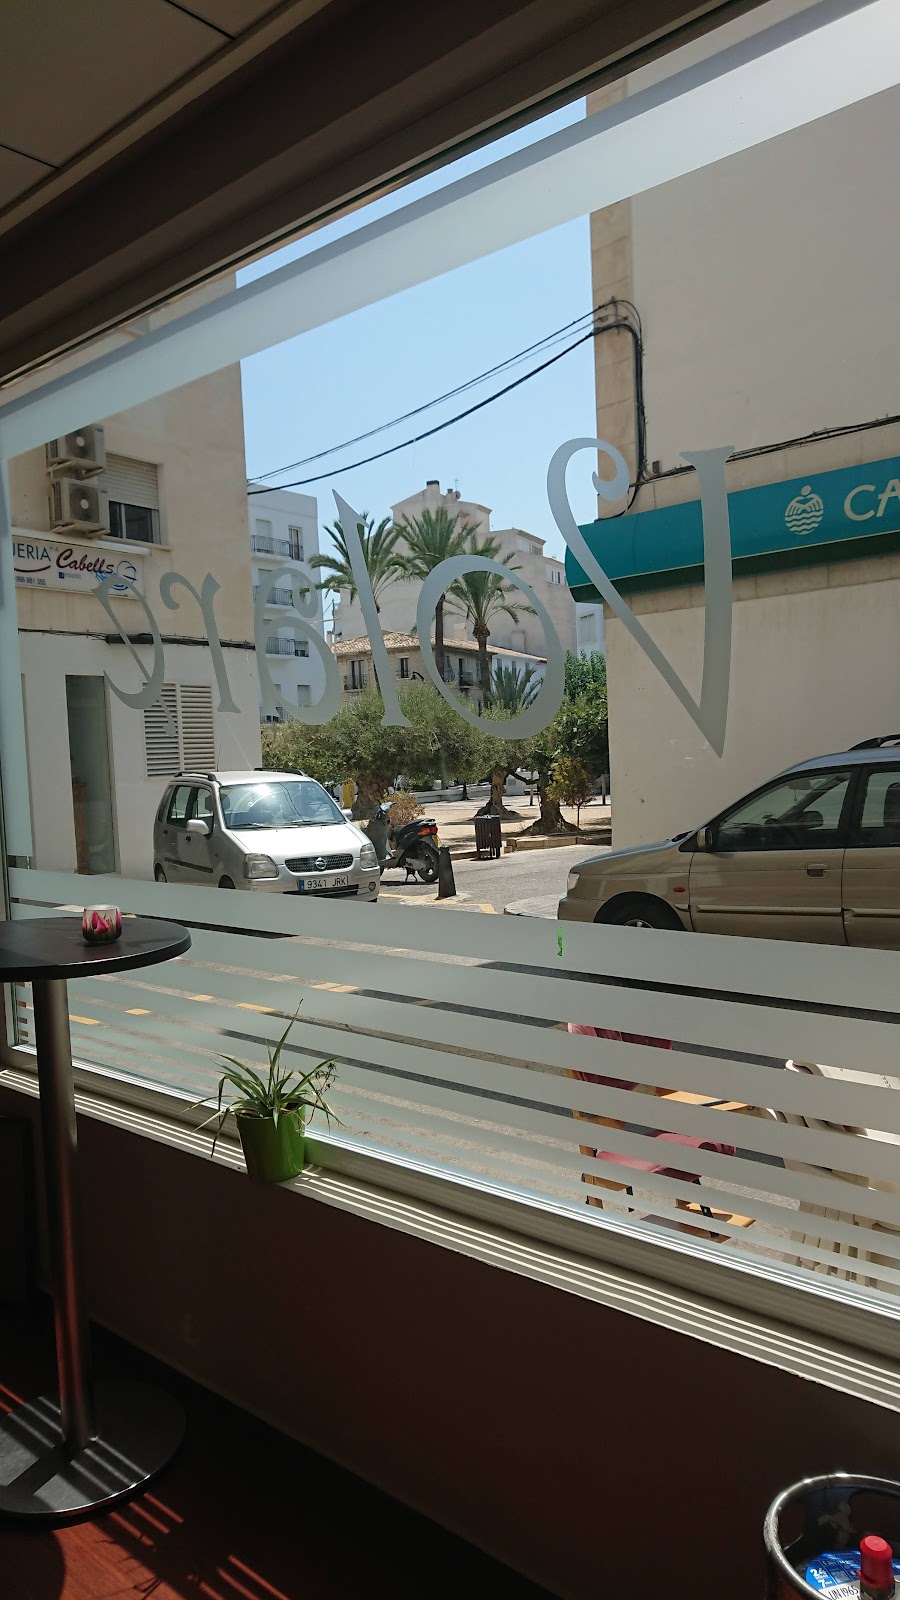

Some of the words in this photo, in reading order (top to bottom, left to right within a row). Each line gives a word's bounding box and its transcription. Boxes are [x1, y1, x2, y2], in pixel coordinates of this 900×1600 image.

[56, 548, 115, 574] Cabells
[307, 879, 327, 889] 9341
[332, 877, 346, 887] JRK
